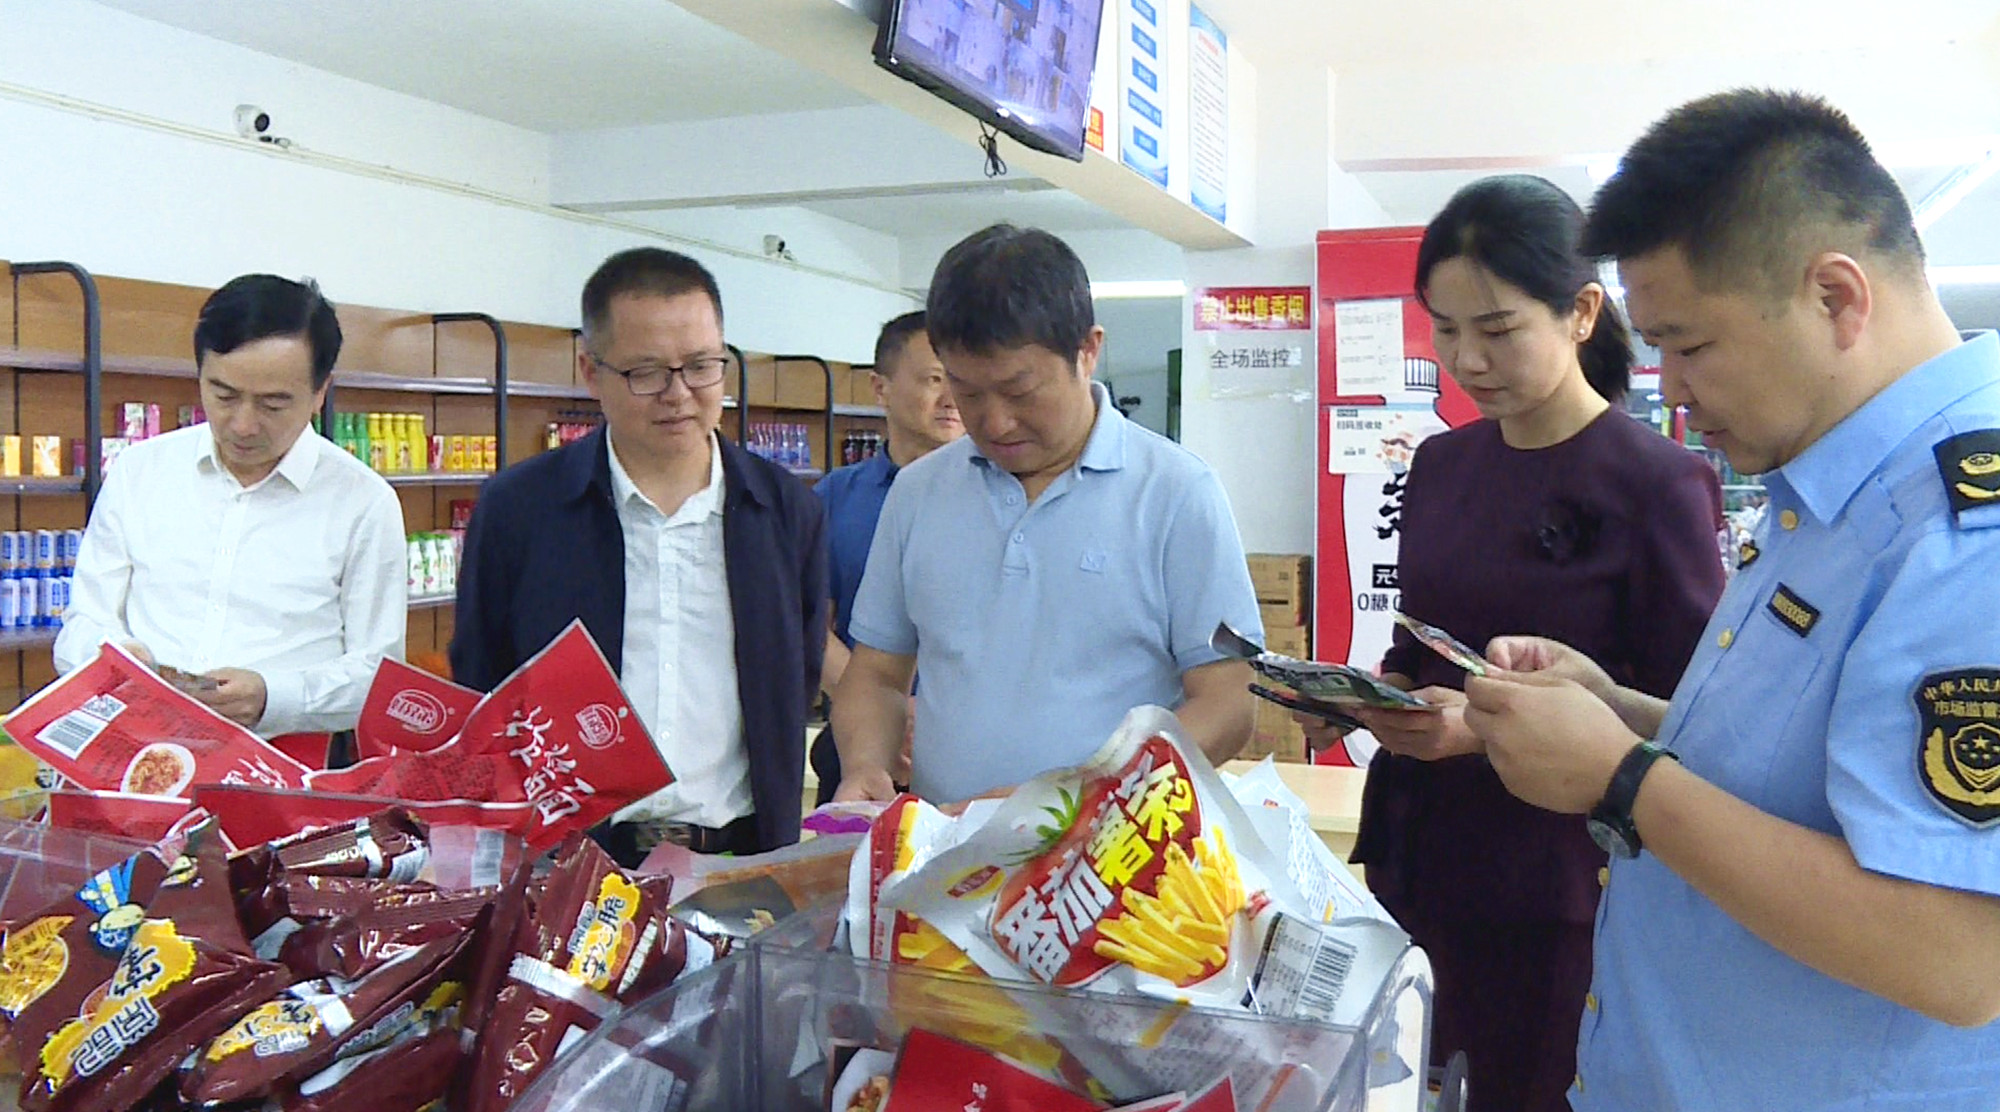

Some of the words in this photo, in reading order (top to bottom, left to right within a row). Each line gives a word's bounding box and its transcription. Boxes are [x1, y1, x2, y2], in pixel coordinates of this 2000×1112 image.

[1202, 294, 1304, 322] 禁止出售香烟
[1210, 347, 1291, 368] 全场监控
